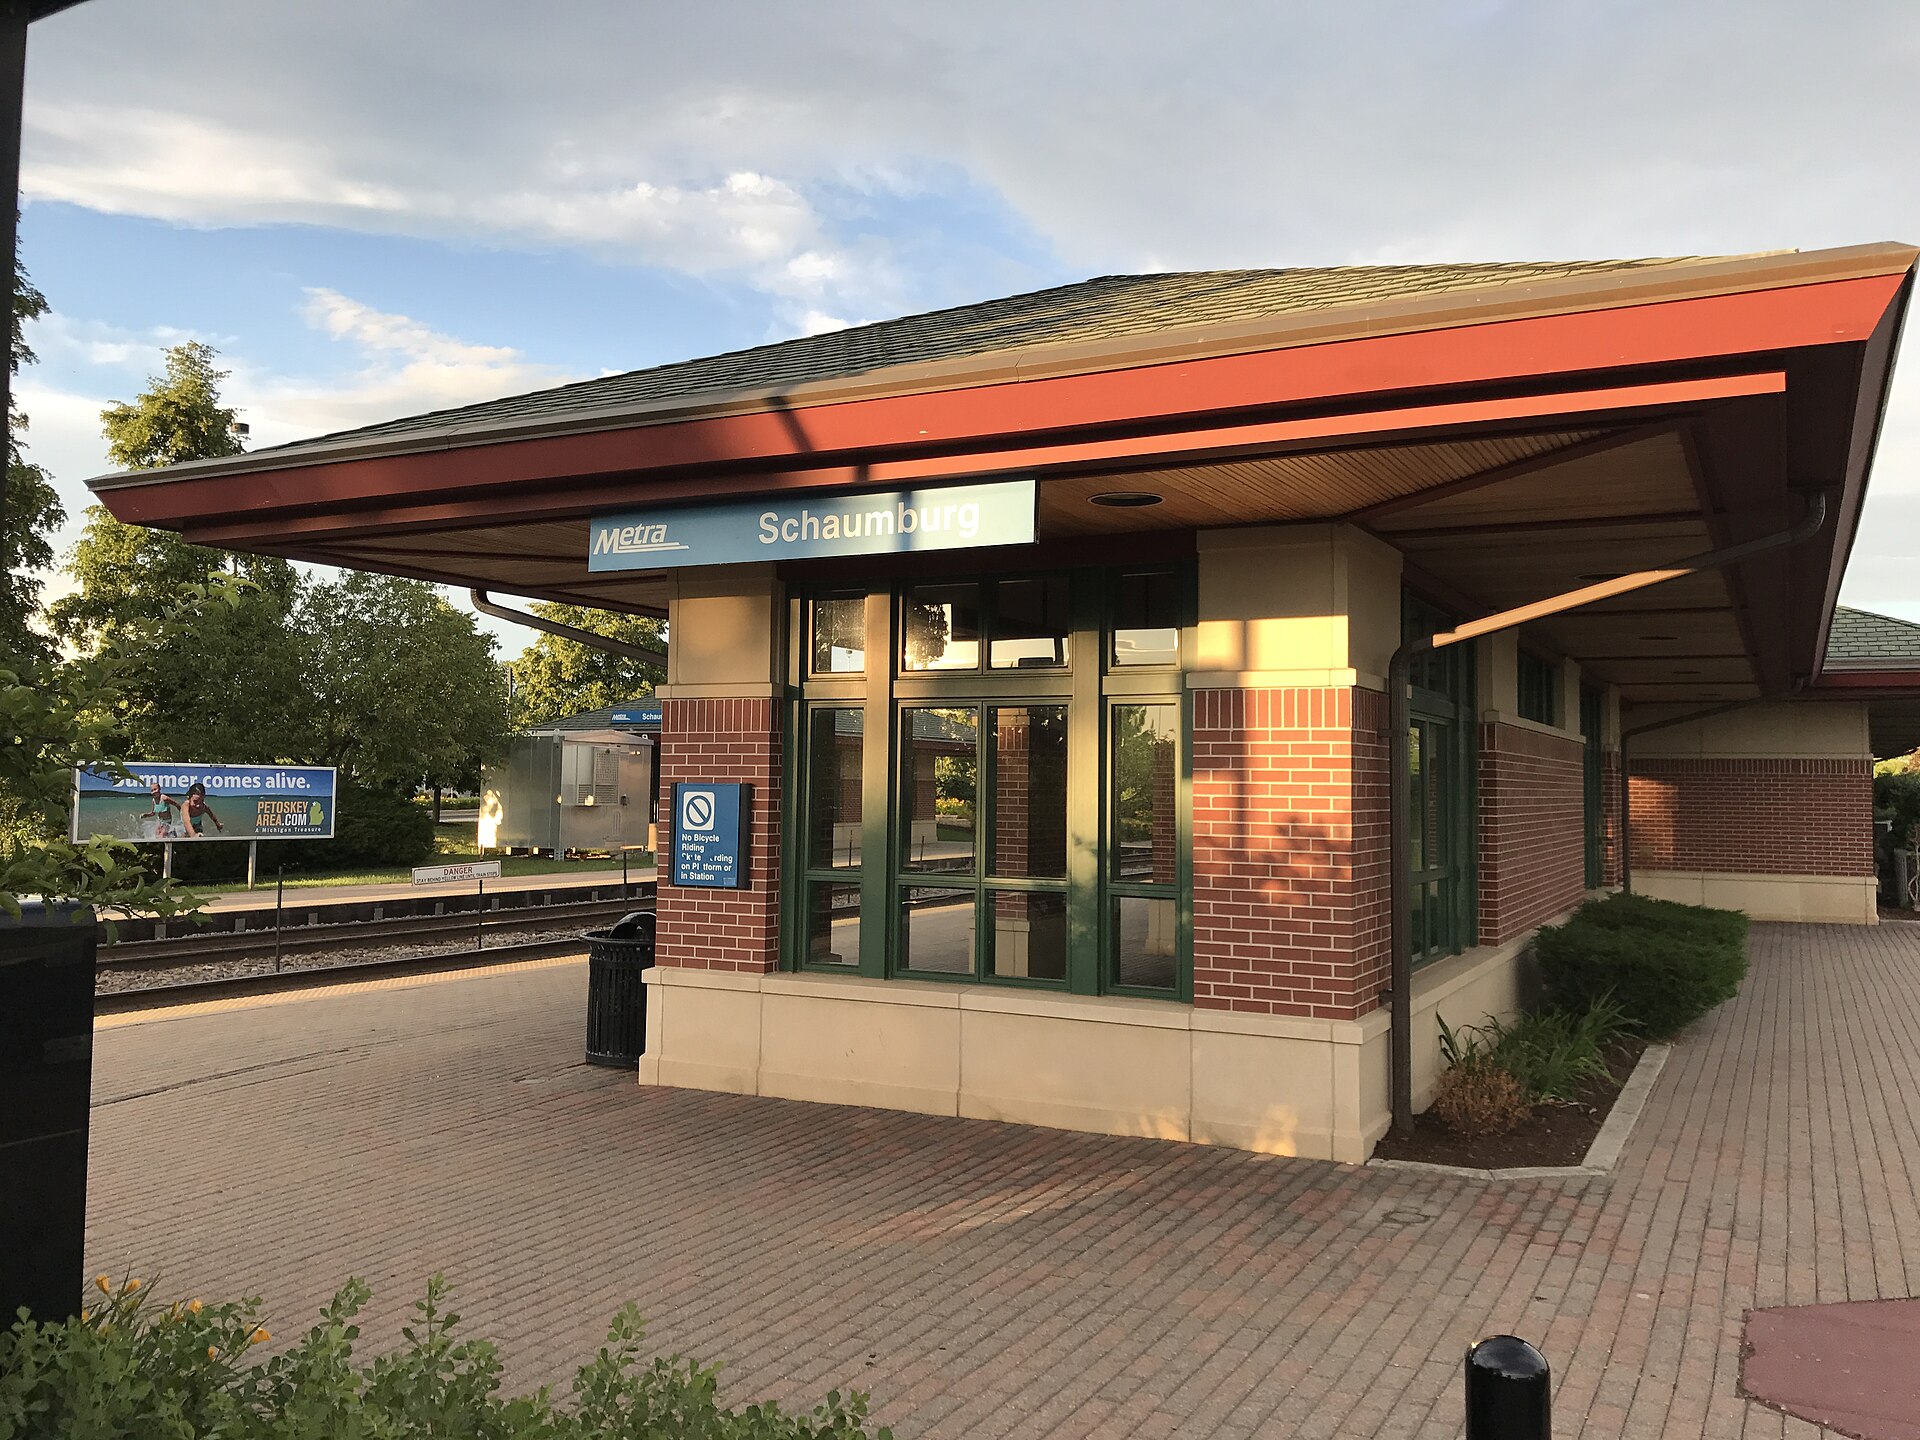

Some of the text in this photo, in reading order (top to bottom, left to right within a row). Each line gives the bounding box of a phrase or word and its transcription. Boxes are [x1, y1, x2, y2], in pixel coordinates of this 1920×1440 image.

[758, 501, 980, 544] Schaumburg
[593, 523, 668, 555] Metra
[642, 712, 662, 720] Schau
[202, 775, 261, 788] comes
[265, 771, 311, 789] alive.
[257, 801, 308, 813] PETOSKEY
[256, 813, 307, 826] AREA.COM
[681, 833, 720, 843] No Bicycle
[681, 843, 705, 853] Riding
[443, 866, 473, 876] DANGER
[692, 862, 722, 871] Pltform
[723, 864, 732, 872] or
[680, 871, 715, 881] in Station
